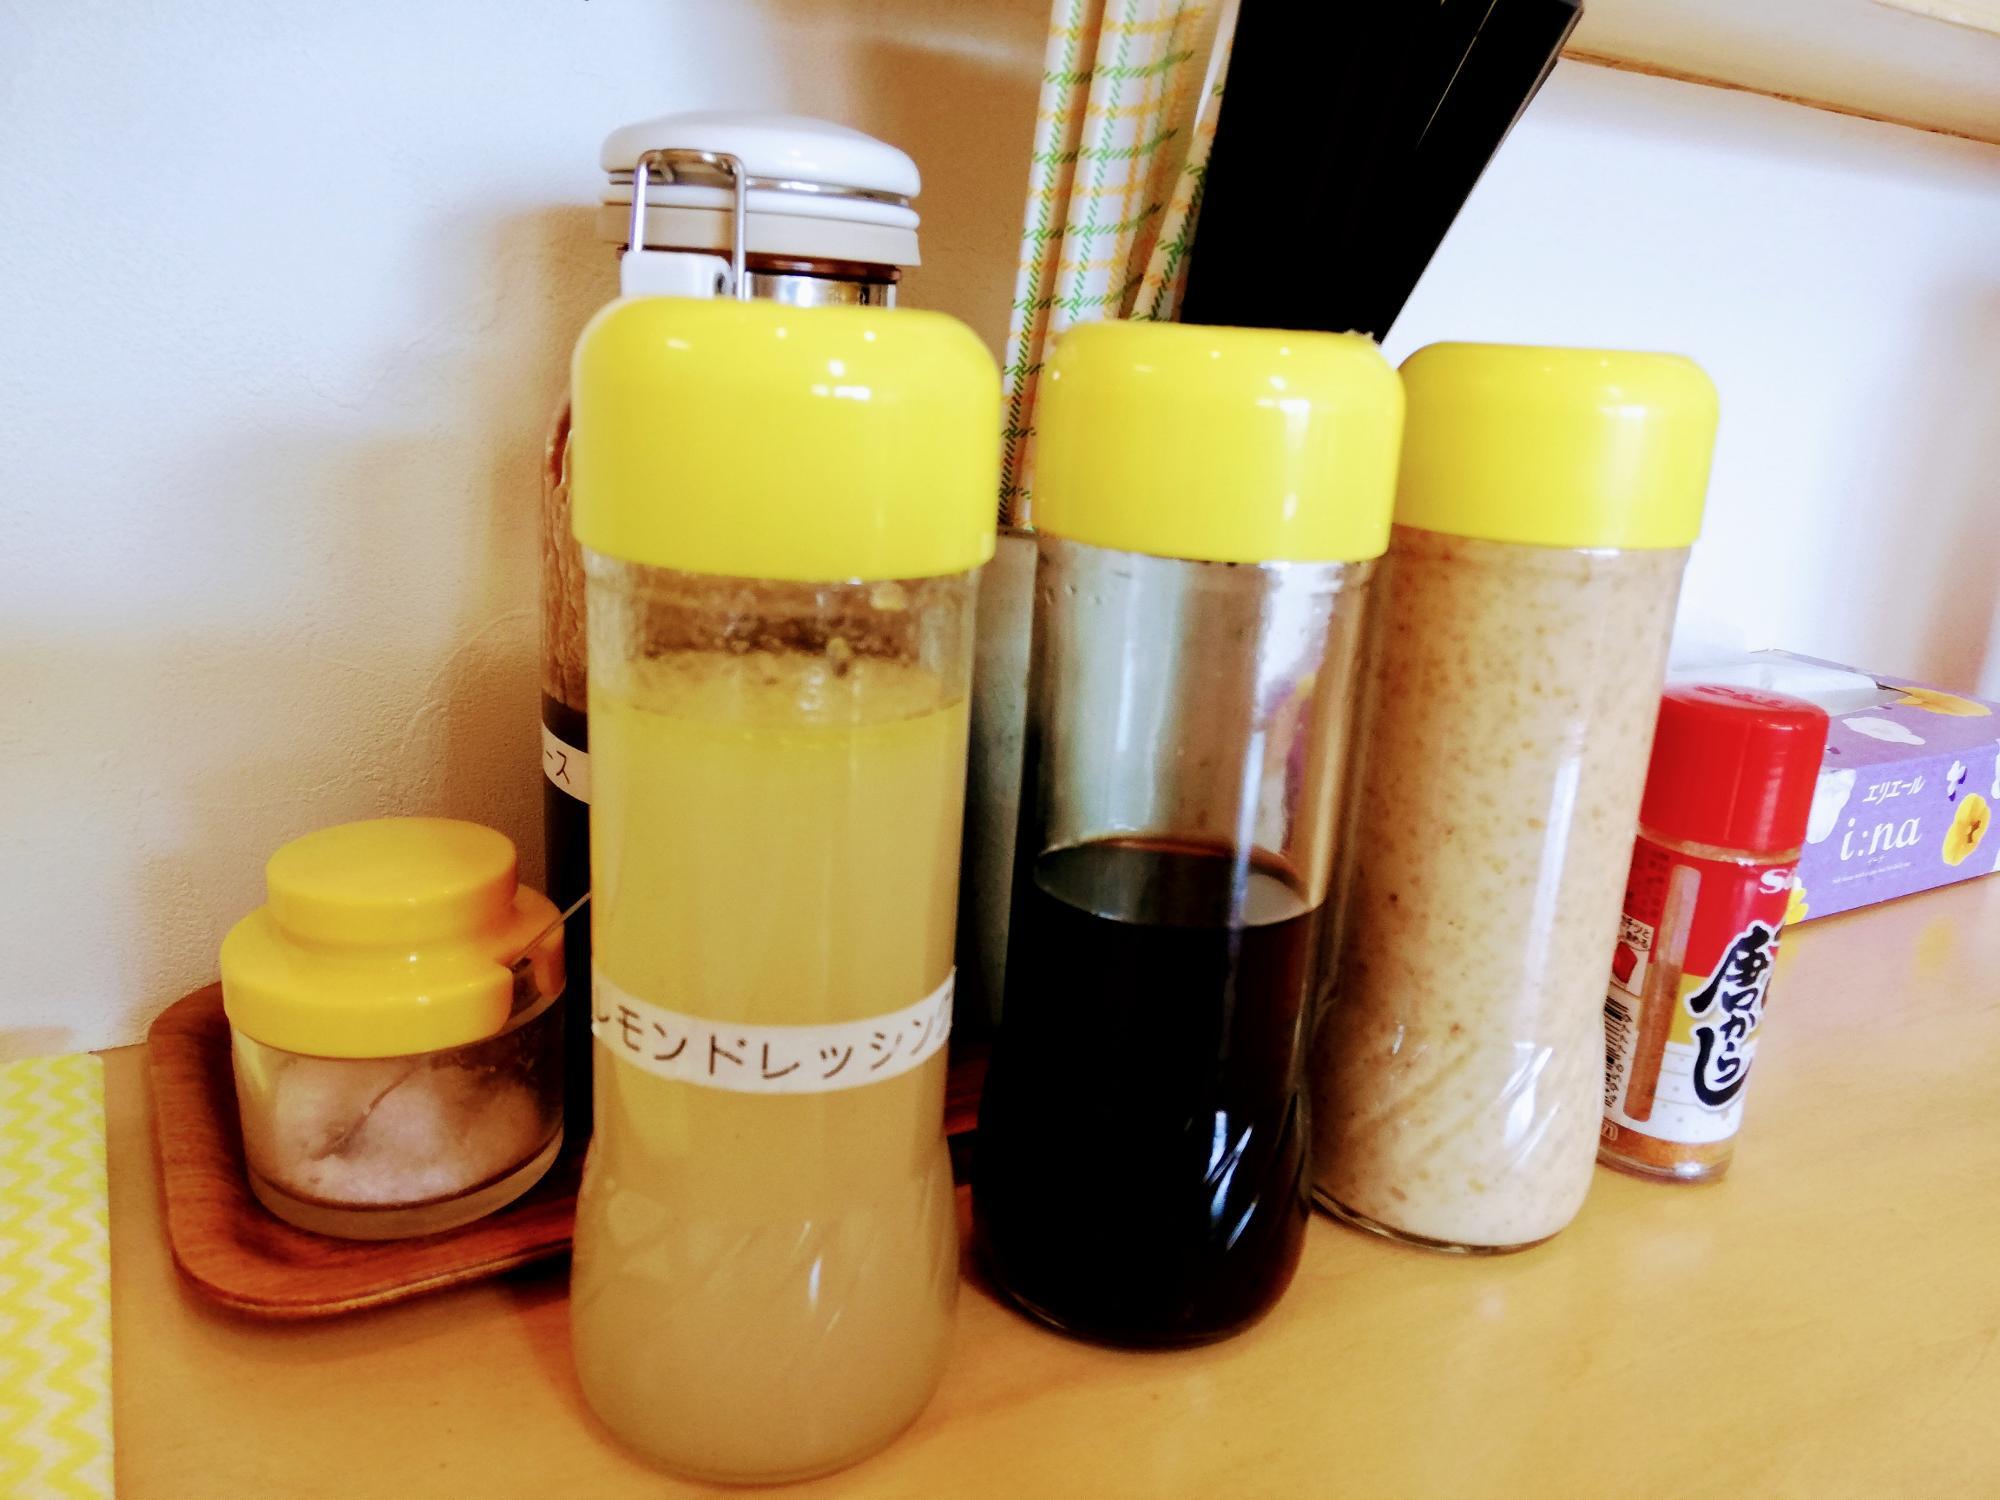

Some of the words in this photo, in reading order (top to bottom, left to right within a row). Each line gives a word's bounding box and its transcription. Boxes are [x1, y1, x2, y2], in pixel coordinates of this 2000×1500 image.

[1862, 776, 1926, 805] エリエール
[1840, 817, 1923, 861] i:na
